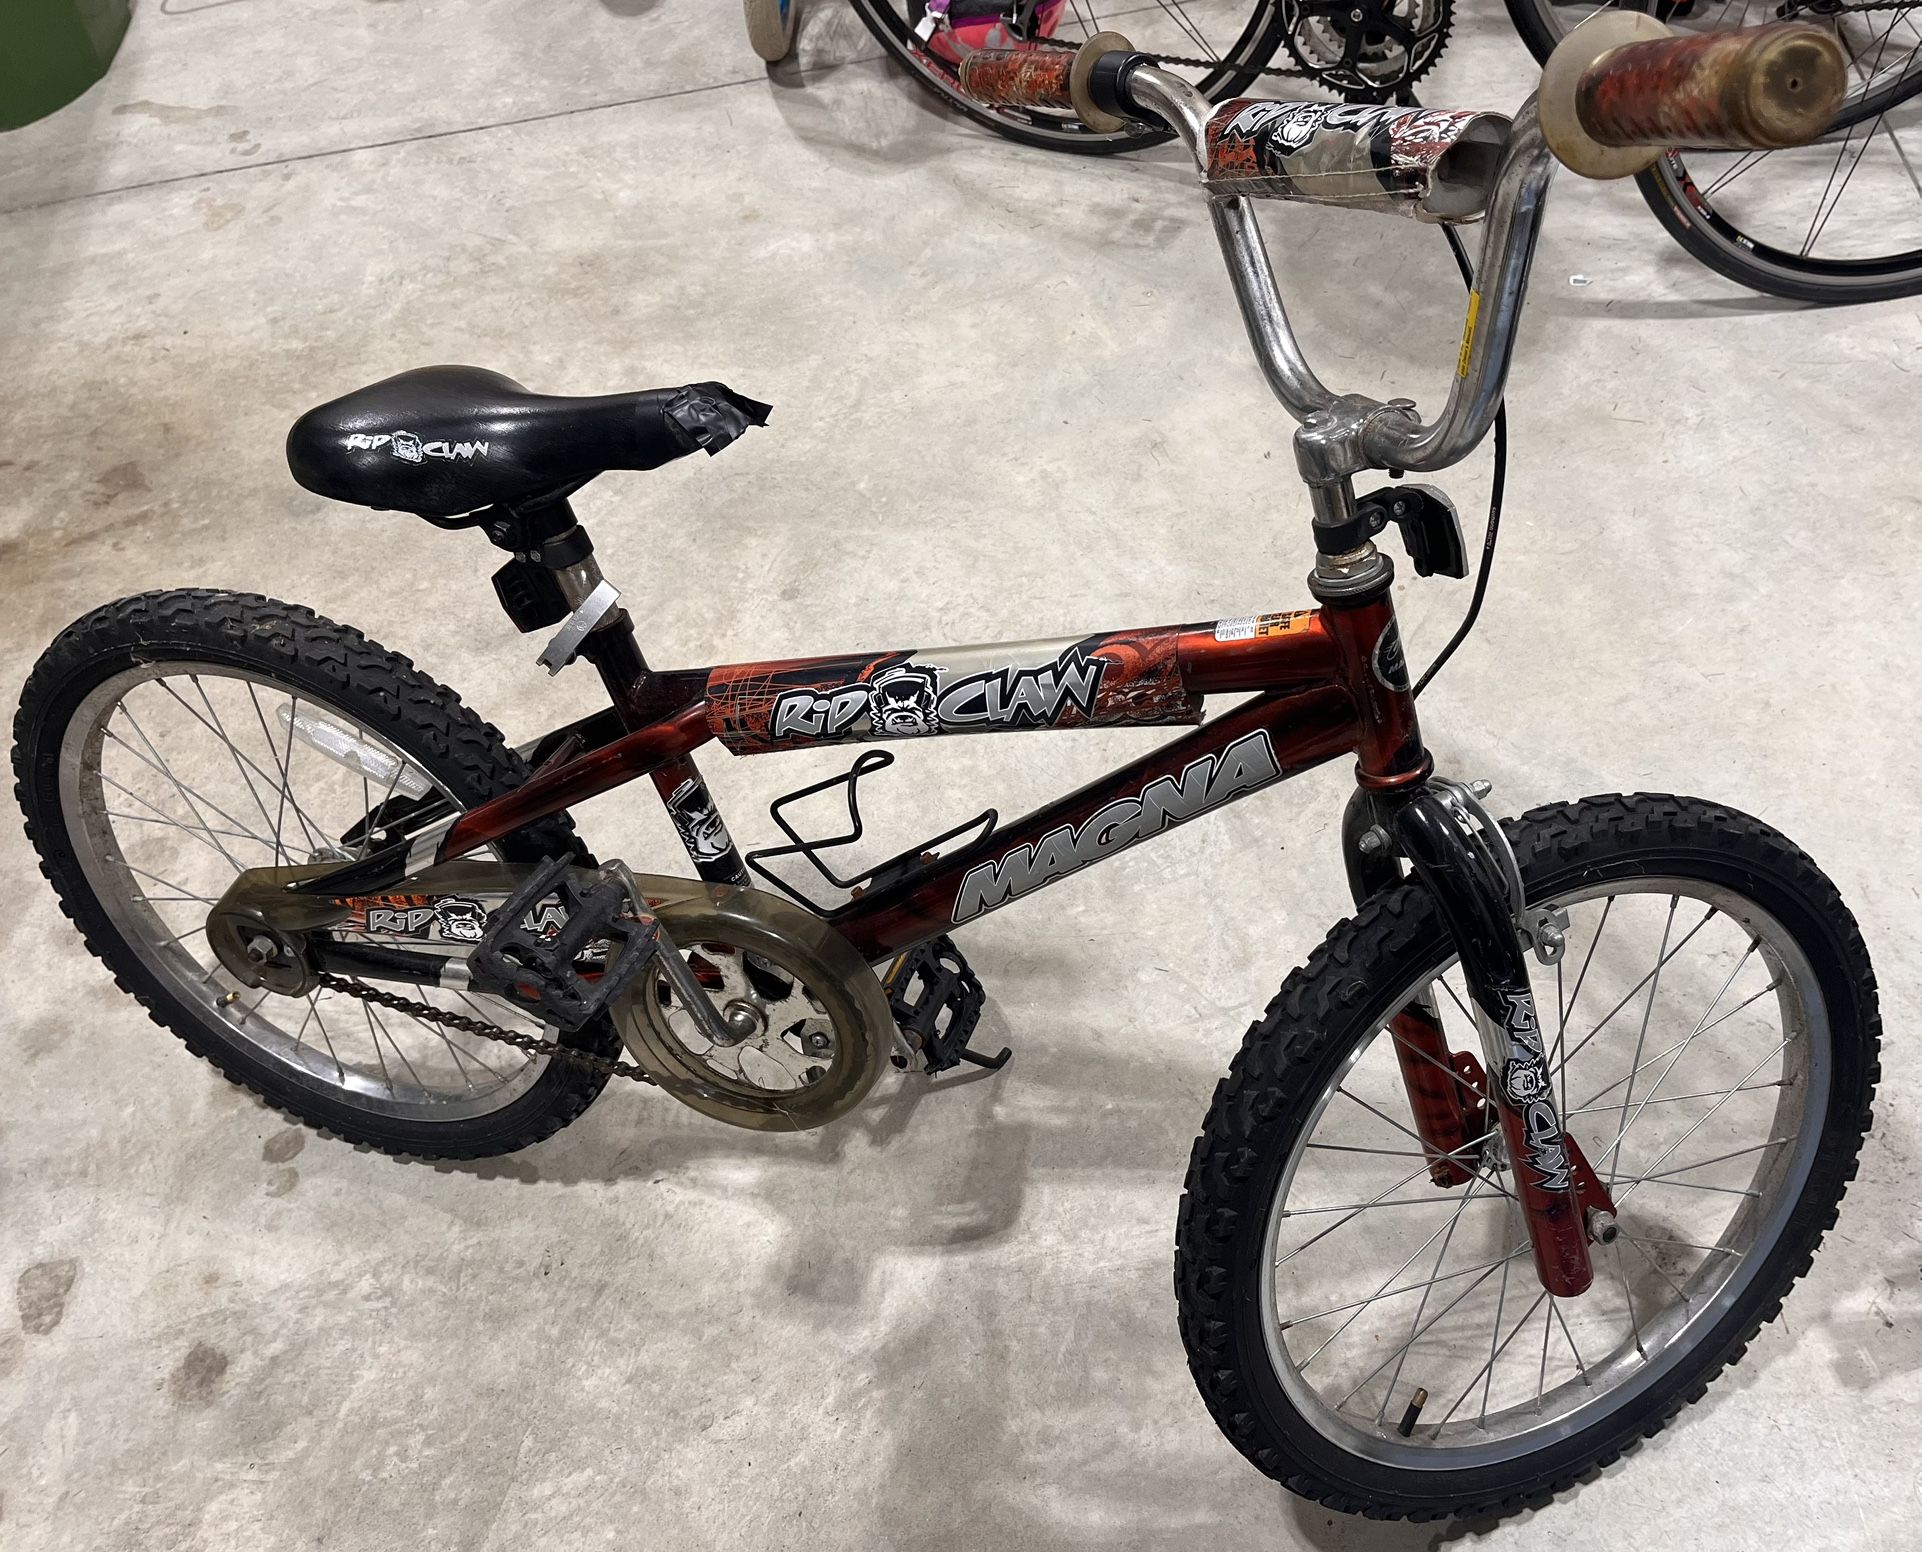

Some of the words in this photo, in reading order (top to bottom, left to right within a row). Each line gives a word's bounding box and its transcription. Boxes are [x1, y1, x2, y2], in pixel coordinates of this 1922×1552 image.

[421, 440, 490, 461] CLAW
[937, 647, 1100, 725] CLAW
[951, 728, 1282, 924] MAGNA
[1528, 1101, 1570, 1189] CLAW
